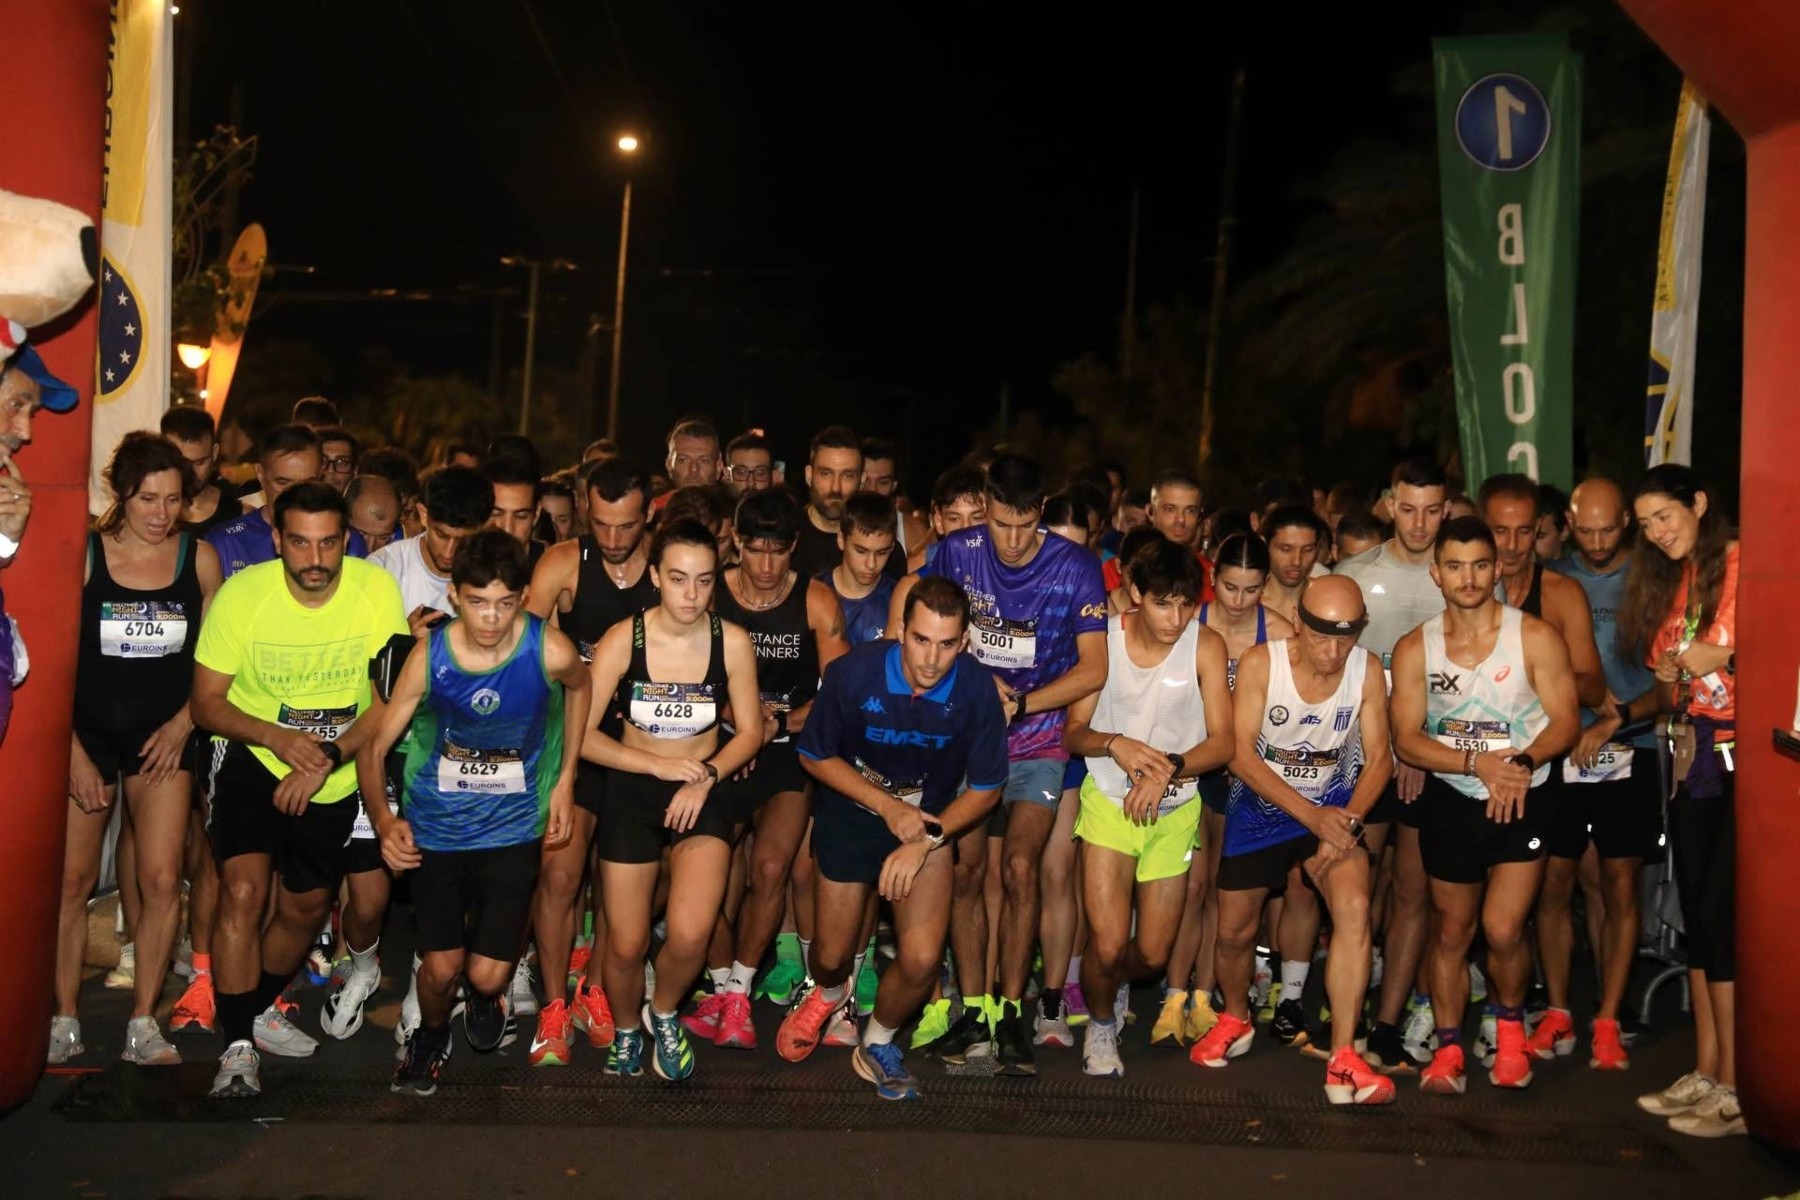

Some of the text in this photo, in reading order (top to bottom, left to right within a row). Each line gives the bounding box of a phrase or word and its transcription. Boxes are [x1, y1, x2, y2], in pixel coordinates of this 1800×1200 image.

[125, 622, 165, 637] 6704
[981, 632, 1014, 649] 5001
[985, 652, 1018, 663] EUROINS
[654, 703, 693, 718] 6628
[300, 726, 338, 740] 55
[1455, 739, 1489, 753] 5530
[459, 762, 499, 775] 6629
[1283, 766, 1319, 779] 5023
